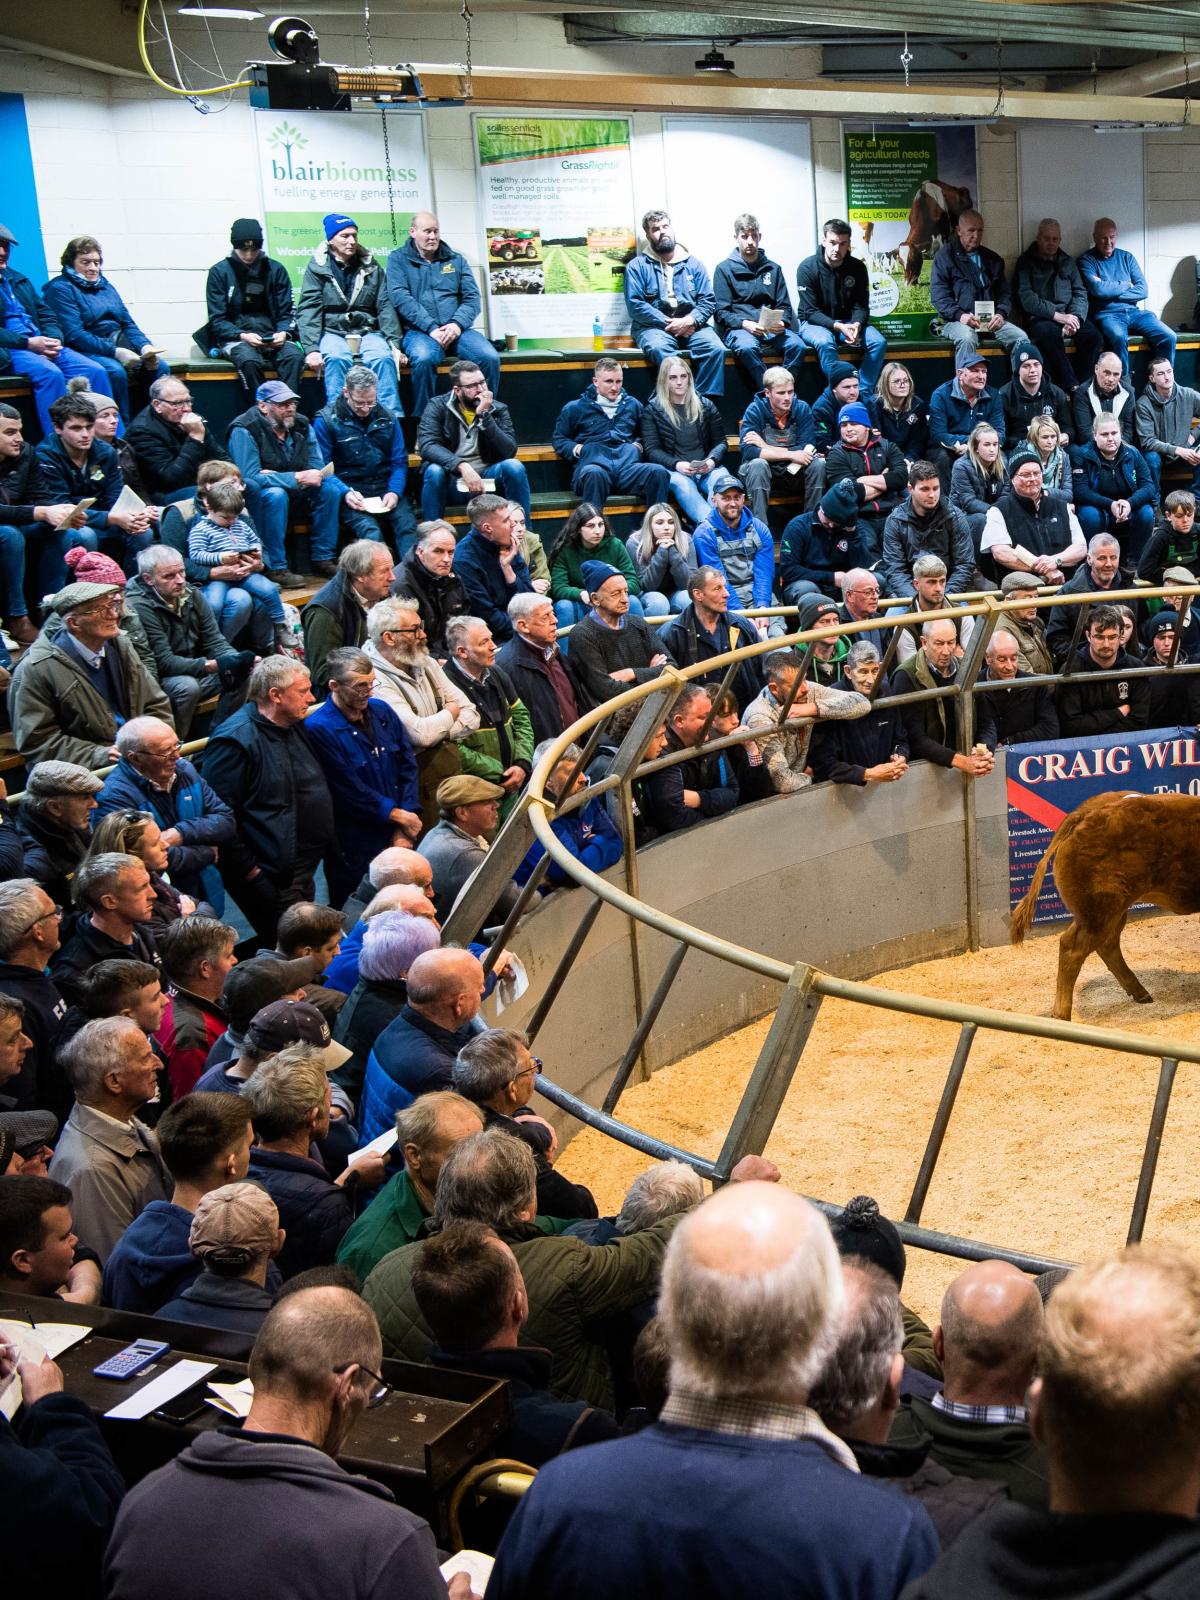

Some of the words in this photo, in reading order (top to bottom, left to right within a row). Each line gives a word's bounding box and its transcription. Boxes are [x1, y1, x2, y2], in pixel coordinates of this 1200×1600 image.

[848, 138, 864, 148] For
[866, 139, 876, 148] all
[880, 140, 900, 149] your
[849, 151, 900, 161] agricultural
[902, 150, 930, 159] needs
[271, 158, 418, 183] blairbiomass
[521, 177, 561, 185] productive
[273, 186, 318, 201] fuelling
[319, 188, 358, 201] energy
[491, 184, 503, 192] fed
[515, 185, 535, 194] good
[536, 186, 555, 194] grass
[508, 194, 542, 202] managed
[853, 211, 872, 219] CALL
[873, 211, 883, 219] US
[884, 211, 908, 219] TODAY
[273, 226, 289, 235] The
[290, 227, 321, 236] greener
[359, 226, 377, 236] oost
[1018, 745, 1133, 785] CRAIG
[1008, 826, 1037, 838] Livestock
[1014, 848, 1043, 858] Livestock
[1031, 914, 1054, 923] Livestock
